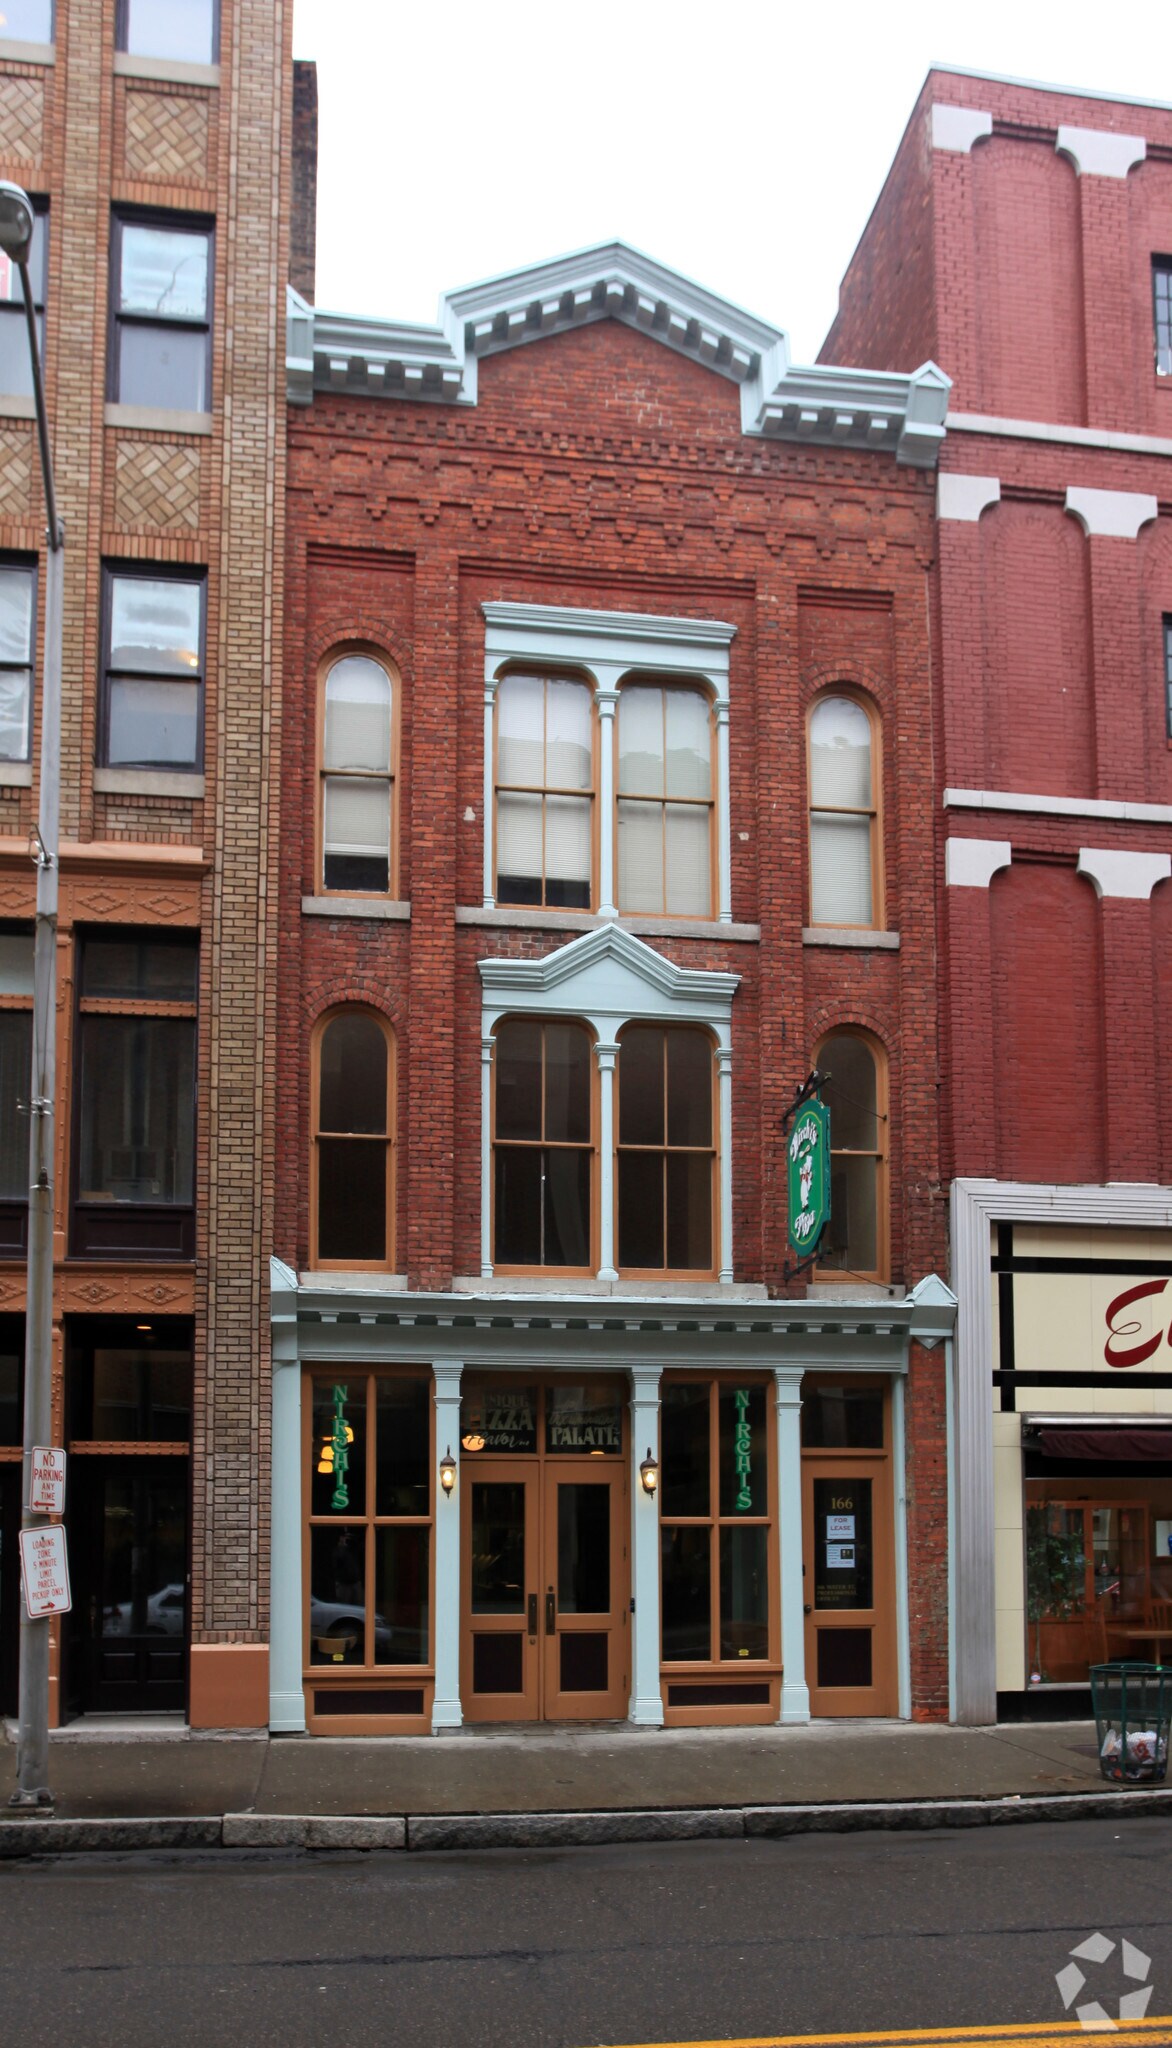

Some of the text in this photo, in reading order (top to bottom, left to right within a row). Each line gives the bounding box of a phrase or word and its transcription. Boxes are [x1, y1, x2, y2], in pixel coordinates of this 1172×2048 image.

[790, 1118, 818, 1162] Nirchi's
[794, 1210, 816, 1239] Pizza
[1104, 1279, 1172, 1368] E
[463, 1408, 535, 1431] PIZZA
[551, 1426, 620, 1446] PALATE
[42, 1454, 56, 1467] NO
[33, 1468, 64, 1482] PARKING
[41, 1482, 55, 1491] ANY
[41, 1491, 56, 1501] TIME
[831, 1497, 854, 1510] 166
[32, 1538, 55, 1549] LOADING
[38, 1549, 51, 1559] ZONE
[39, 1558, 57, 1568] MINUTE
[40, 1569, 52, 1579] LIMIT
[37, 1579, 57, 1589] PARCEL
[32, 1588, 64, 1600] PICKUP ONLY
